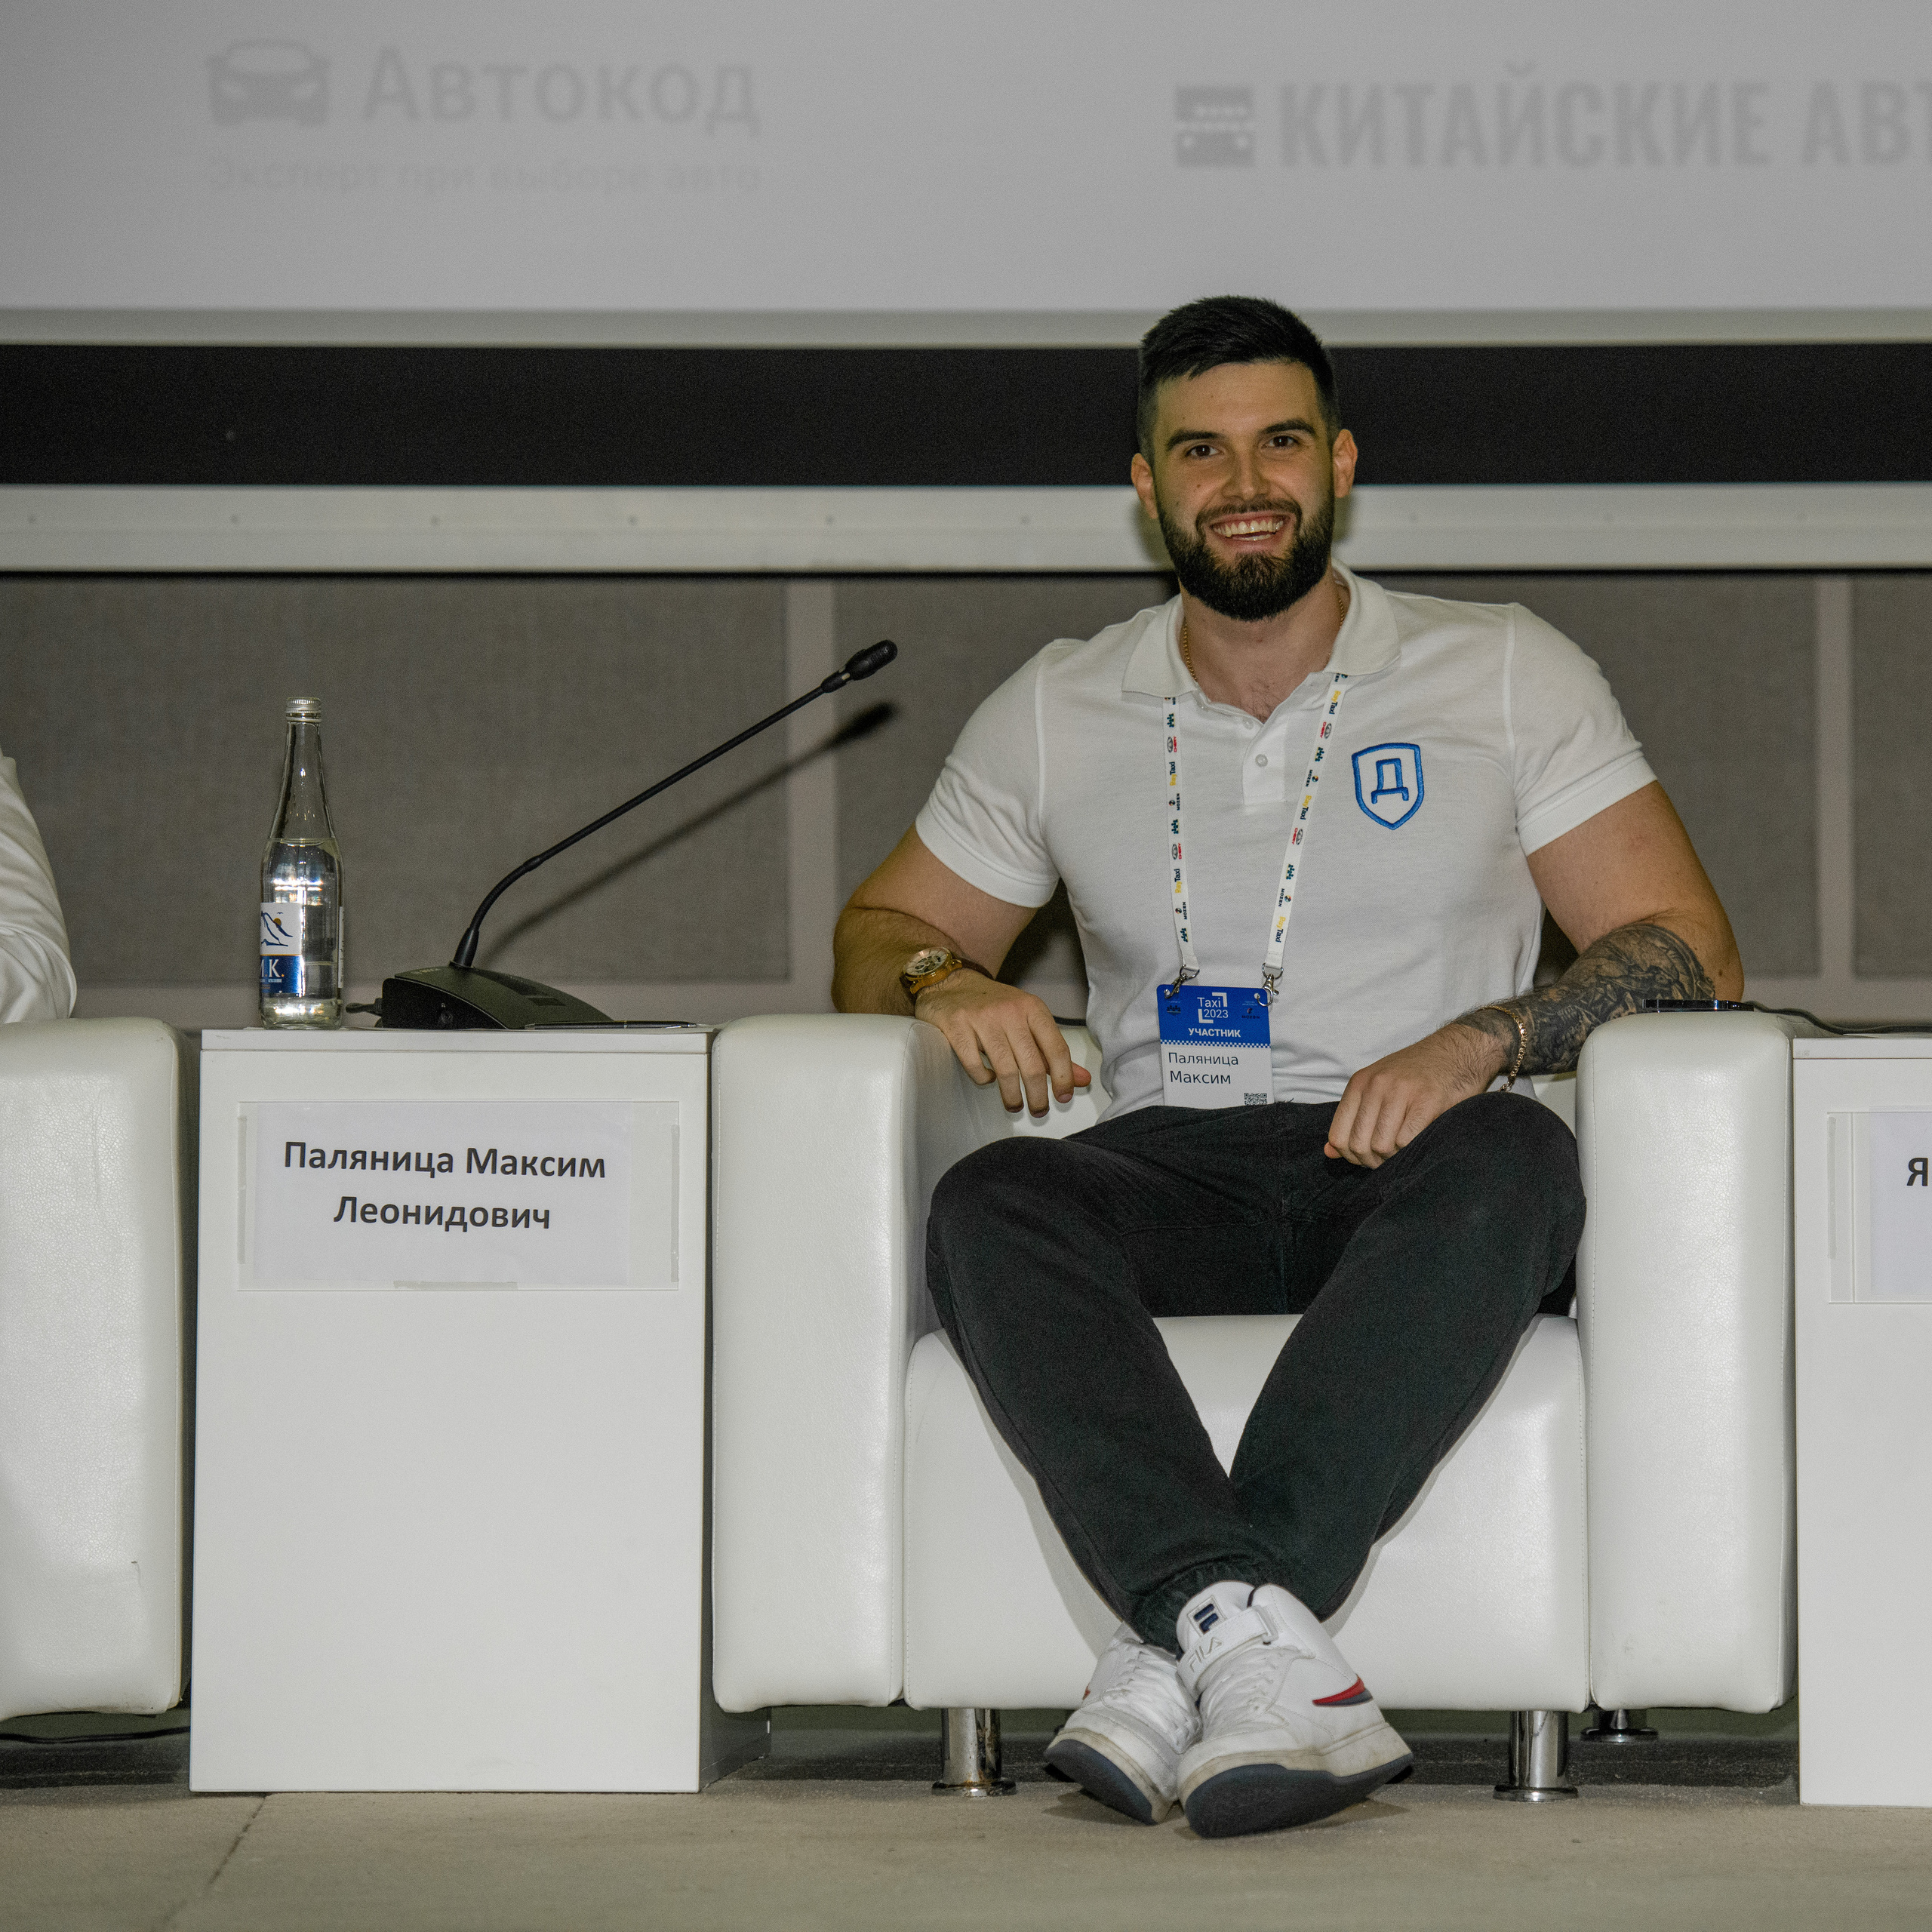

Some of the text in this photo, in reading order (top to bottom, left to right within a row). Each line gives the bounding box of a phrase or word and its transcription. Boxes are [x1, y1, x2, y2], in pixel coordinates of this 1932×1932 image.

[360, 44, 762, 137] Автокод
[1278, 58, 1772, 168] КИТАЙСКИЕ
[209, 155, 762, 194] Эксперт при выборе авто
[1305, 769, 1313, 787] MOZEN
[1371, 758, 1409, 804] Д
[1275, 915, 1286, 943] RayTaxi
[1197, 997, 1221, 1008] Taxi
[1204, 1009, 1229, 1018] 2023
[1188, 1027, 1241, 1038] УЧАСТНИК
[1168, 1052, 1239, 1066] Паляница
[1170, 1070, 1232, 1084] Максим
[285, 1140, 607, 1179] Паляница Максим
[334, 1195, 551, 1232] Леонидович
[1187, 1637, 1225, 1673] FILA
